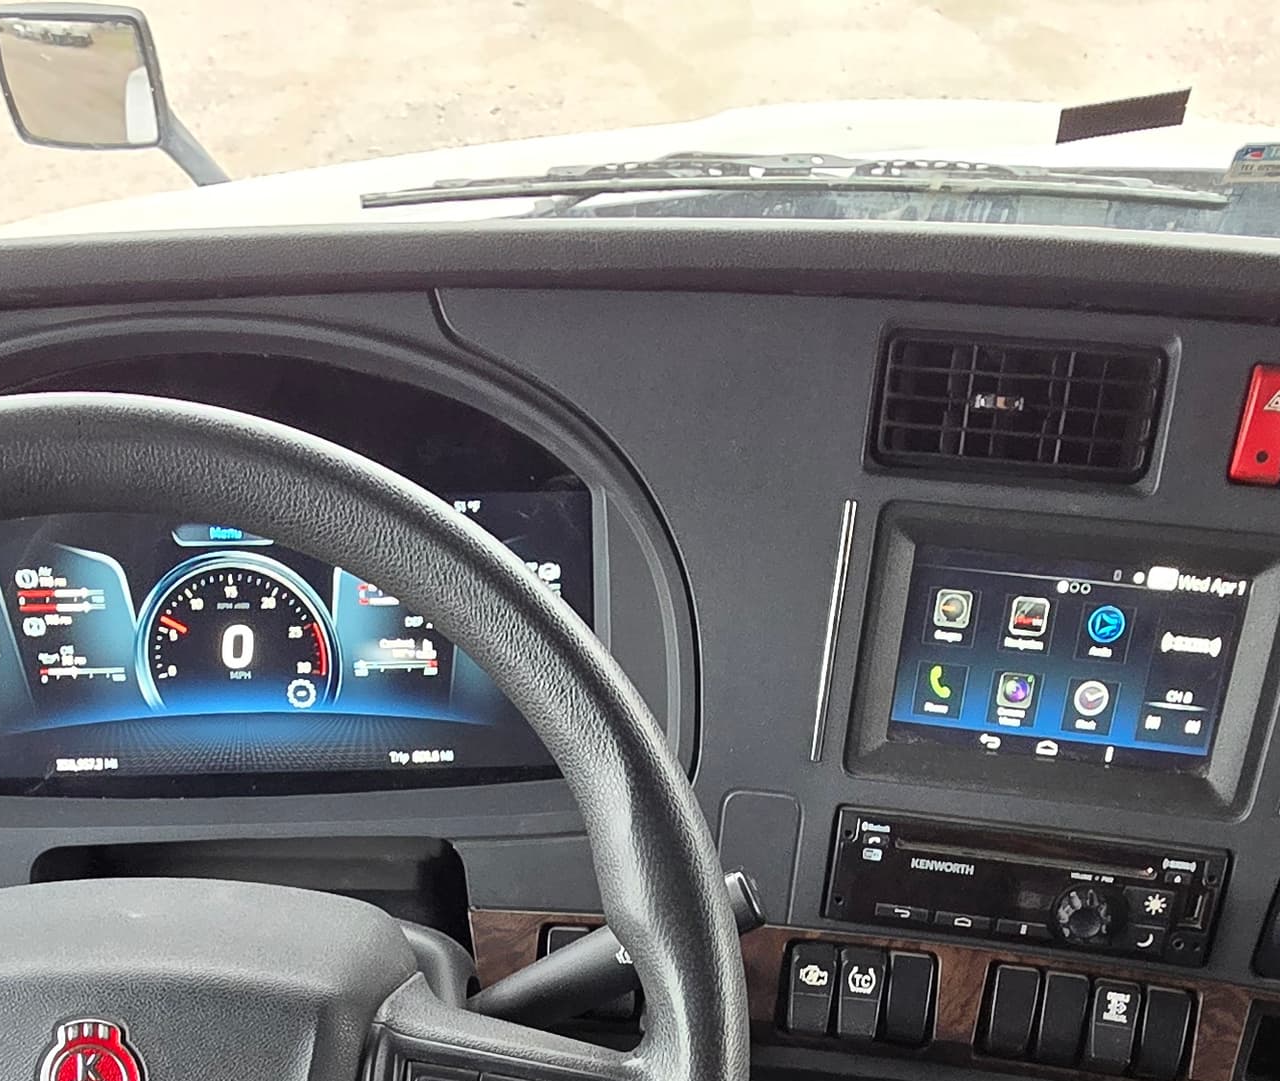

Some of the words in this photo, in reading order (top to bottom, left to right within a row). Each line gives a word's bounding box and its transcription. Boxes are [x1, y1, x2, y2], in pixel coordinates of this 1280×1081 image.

[224, 585, 239, 599] 15
[1178, 574, 1211, 593] Wed
[1210, 578, 1238, 598] Apr
[221, 623, 255, 670] 0
[229, 671, 252, 680] MPH
[388, 750, 410, 766] Trip
[910, 857, 975, 875] KENWORTH
[853, 973, 872, 988] TC
[77, 1053, 101, 1081] K
